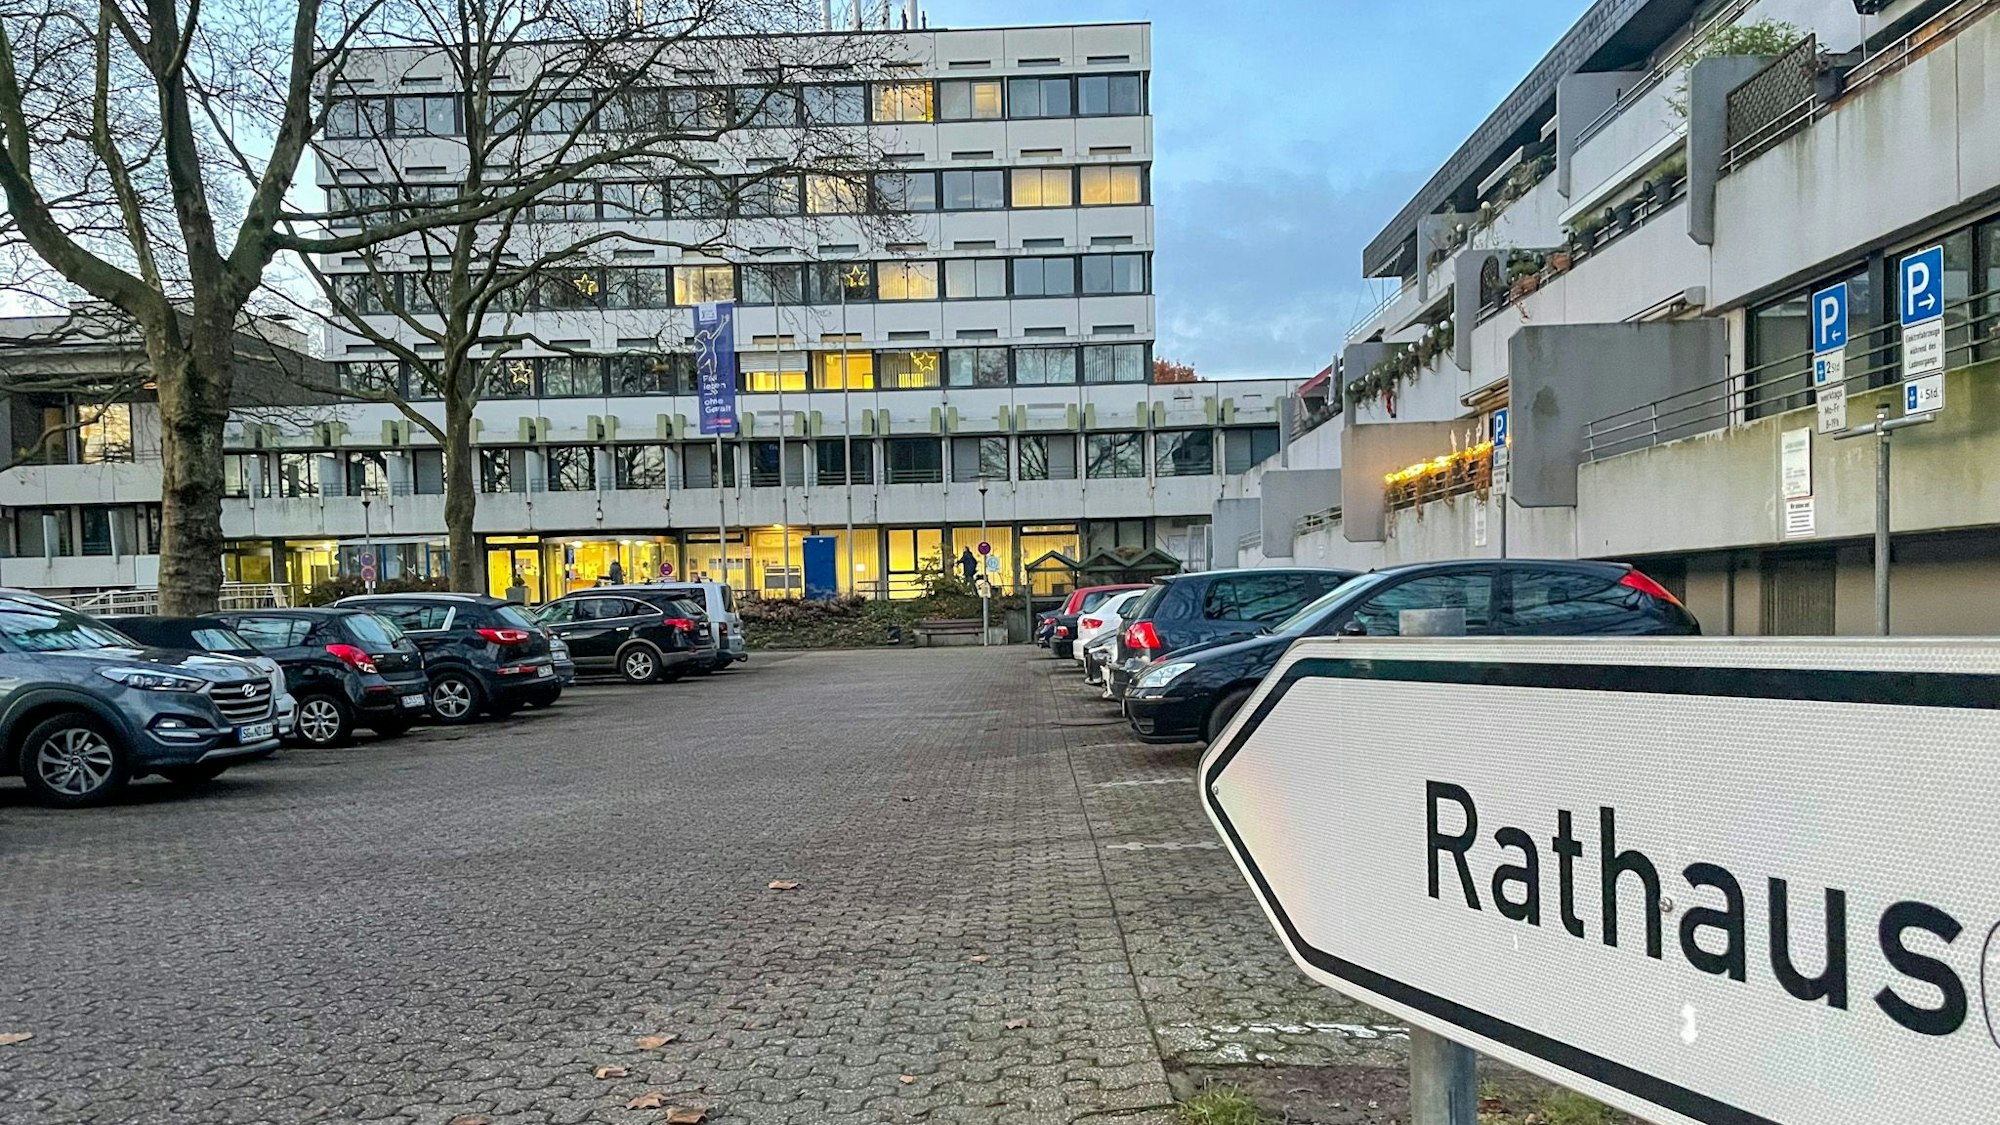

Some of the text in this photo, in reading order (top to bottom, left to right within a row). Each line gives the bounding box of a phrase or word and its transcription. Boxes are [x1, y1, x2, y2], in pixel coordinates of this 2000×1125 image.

[1908, 262, 1930, 316] P
[1821, 296, 1839, 345] P
[1826, 361, 1831, 374] 2
[1496, 415, 1504, 443] P
[1426, 779, 1967, 1036] Rathaus
